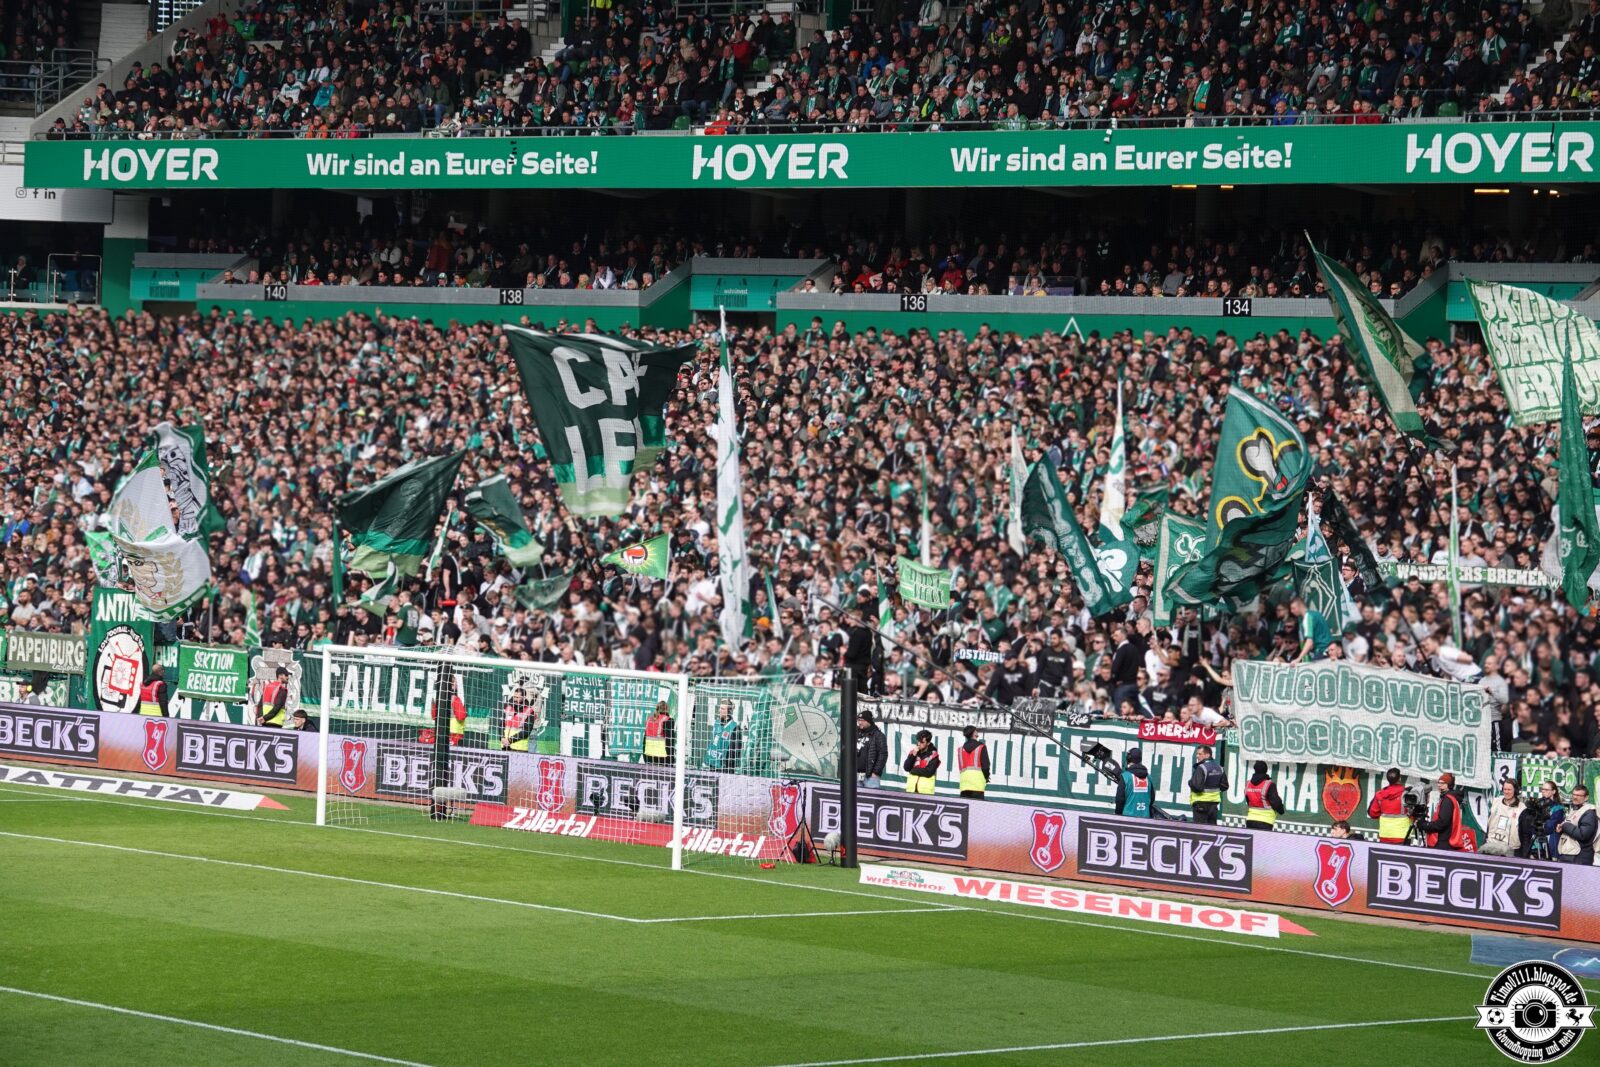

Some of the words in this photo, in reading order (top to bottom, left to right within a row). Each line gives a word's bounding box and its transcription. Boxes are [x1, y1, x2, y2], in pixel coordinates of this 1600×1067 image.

[83, 147, 219, 182] HOYER
[306, 153, 349, 176] Wir
[353, 151, 405, 176] sind
[409, 157, 440, 176] an
[446, 152, 517, 175] Eurer
[521, 150, 598, 174] Seite!
[692, 143, 849, 181] HOYER
[950, 147, 1001, 172] Wir
[1005, 144, 1066, 172] sind
[1071, 151, 1107, 171] an
[1114, 144, 1198, 171] Eurer
[1202, 142, 1293, 169] Seite!
[1405, 131, 1595, 174] HOYER
[265, 286, 287, 300] 140
[501, 289, 523, 304] 138
[902, 296, 925, 311] 136
[1225, 299, 1250, 314] 134
[9, 634, 86, 669] PAPENBURG
[193, 650, 235, 670] SEKTION
[186, 672, 239, 694] REISELUST
[566, 687, 581, 699] DE
[1235, 662, 1484, 727] Videobeweis
[879, 702, 913, 721] WILL
[913, 705, 929, 723] IS
[181, 731, 294, 774] BECK'S
[1240, 711, 1478, 778] abschaffen!
[382, 753, 505, 797] BEK'S
[1136, 802, 1146, 811] 25
[503, 807, 597, 838] Zillertal
[1086, 827, 1248, 881] BECK'S
[866, 875, 946, 892] WIESENHOF
[1375, 858, 1554, 918] BECK'S
[953, 876, 1270, 933] WIESENHOF
